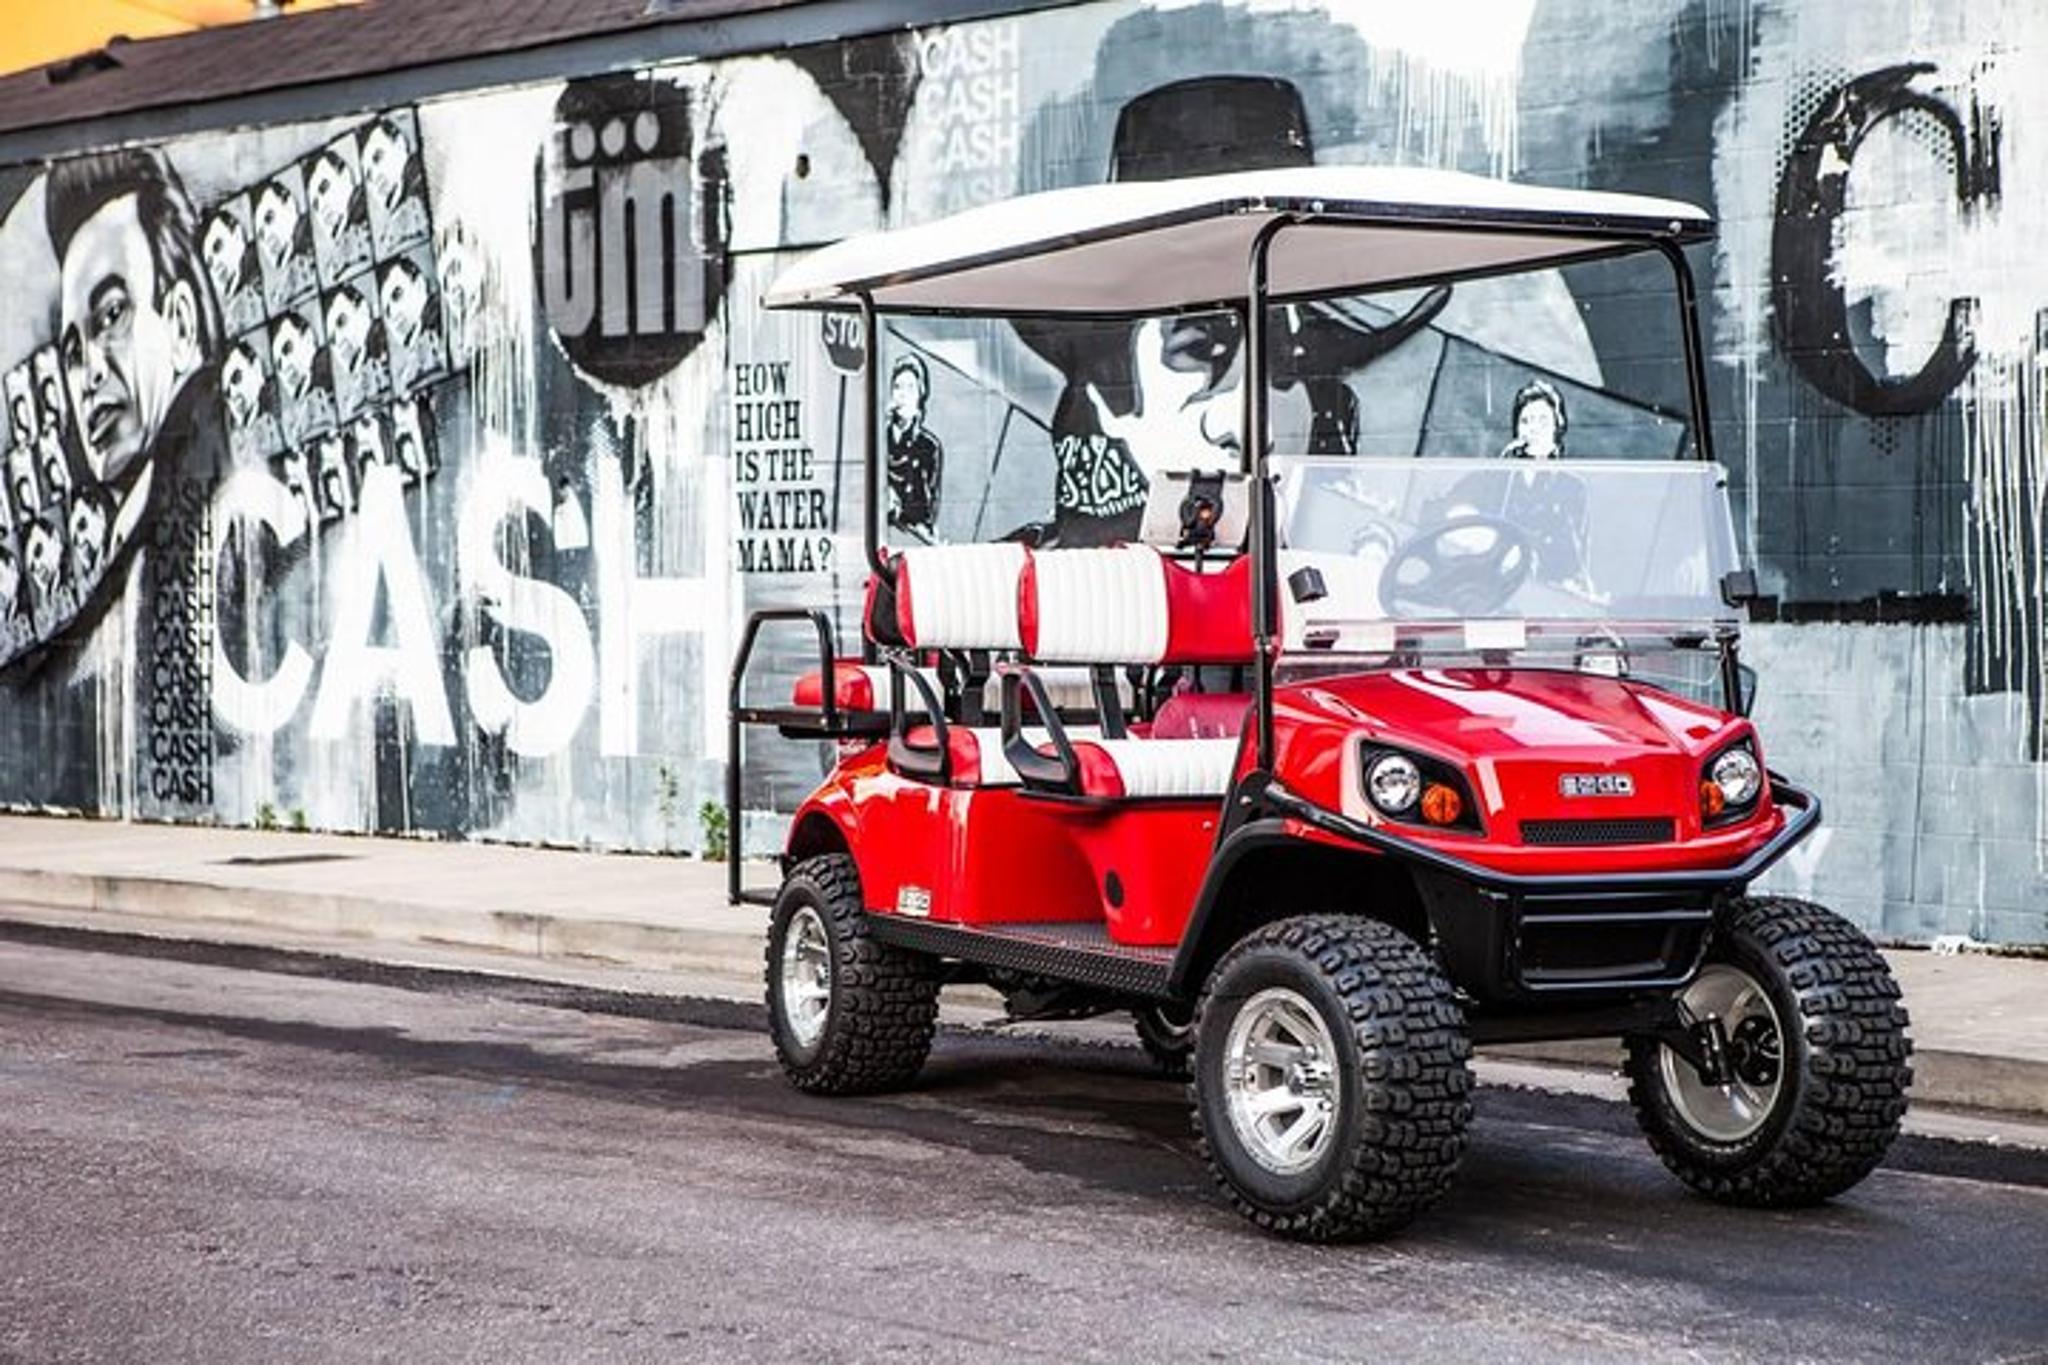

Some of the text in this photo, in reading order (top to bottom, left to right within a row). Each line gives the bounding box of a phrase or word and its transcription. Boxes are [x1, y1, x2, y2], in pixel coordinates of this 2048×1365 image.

[921, 22, 1019, 79] CASH
[922, 70, 1019, 125] CASH
[825, 313, 863, 347] STO
[735, 361, 790, 396] HOW
[735, 400, 801, 442] HIGH
[736, 448, 814, 483] IS THE
[737, 488, 829, 531] WATER
[737, 536, 832, 573] MAMA?
[153, 588, 213, 623] CASH
[211, 452, 730, 760] CASH
[153, 624, 213, 660] CASH
[152, 660, 213, 694] CASH
[152, 695, 213, 730] CASH
[152, 730, 213, 767] CASH
[152, 767, 214, 804] CASH
